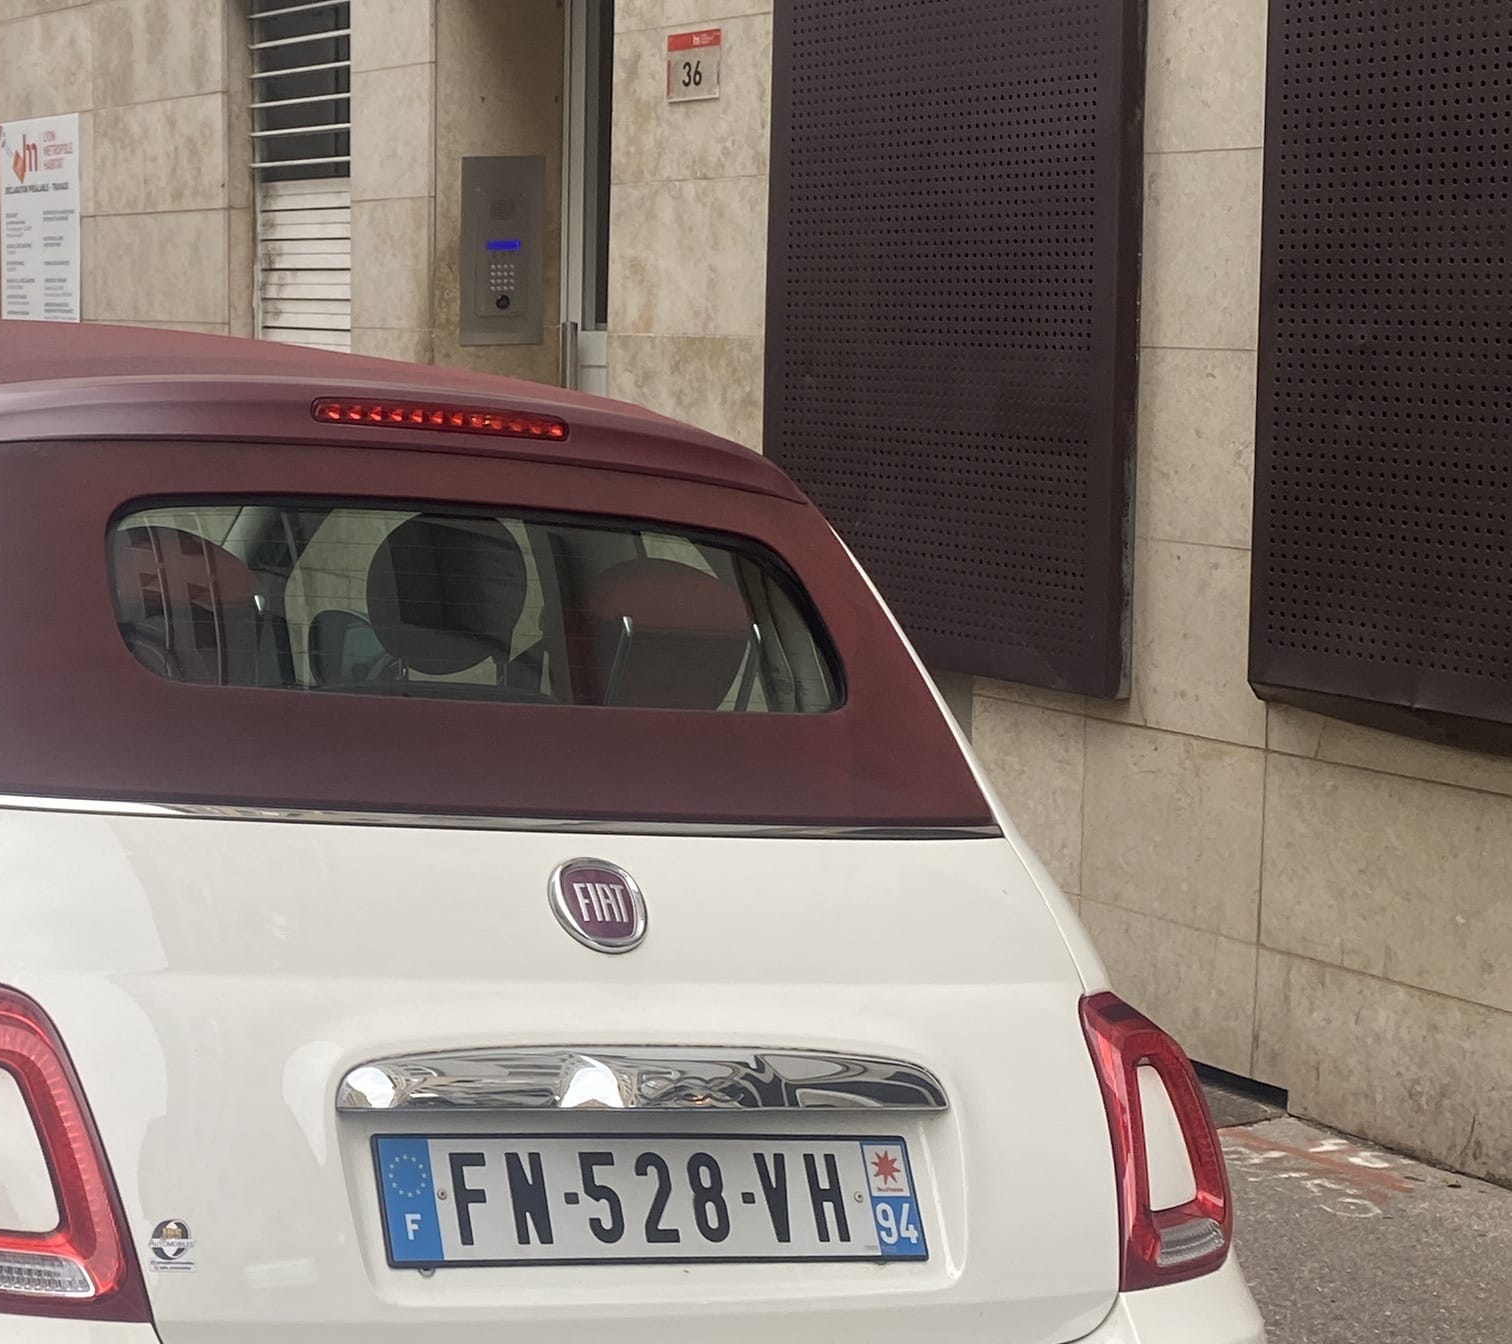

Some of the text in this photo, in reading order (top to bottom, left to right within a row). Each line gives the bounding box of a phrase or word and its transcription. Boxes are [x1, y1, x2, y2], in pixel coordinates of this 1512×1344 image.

[682, 60, 703, 87] 36
[572, 882, 630, 923] FIAT
[447, 1151, 852, 1246] FN-528-VH
[404, 1213, 422, 1241] F
[875, 1202, 919, 1245] 94
